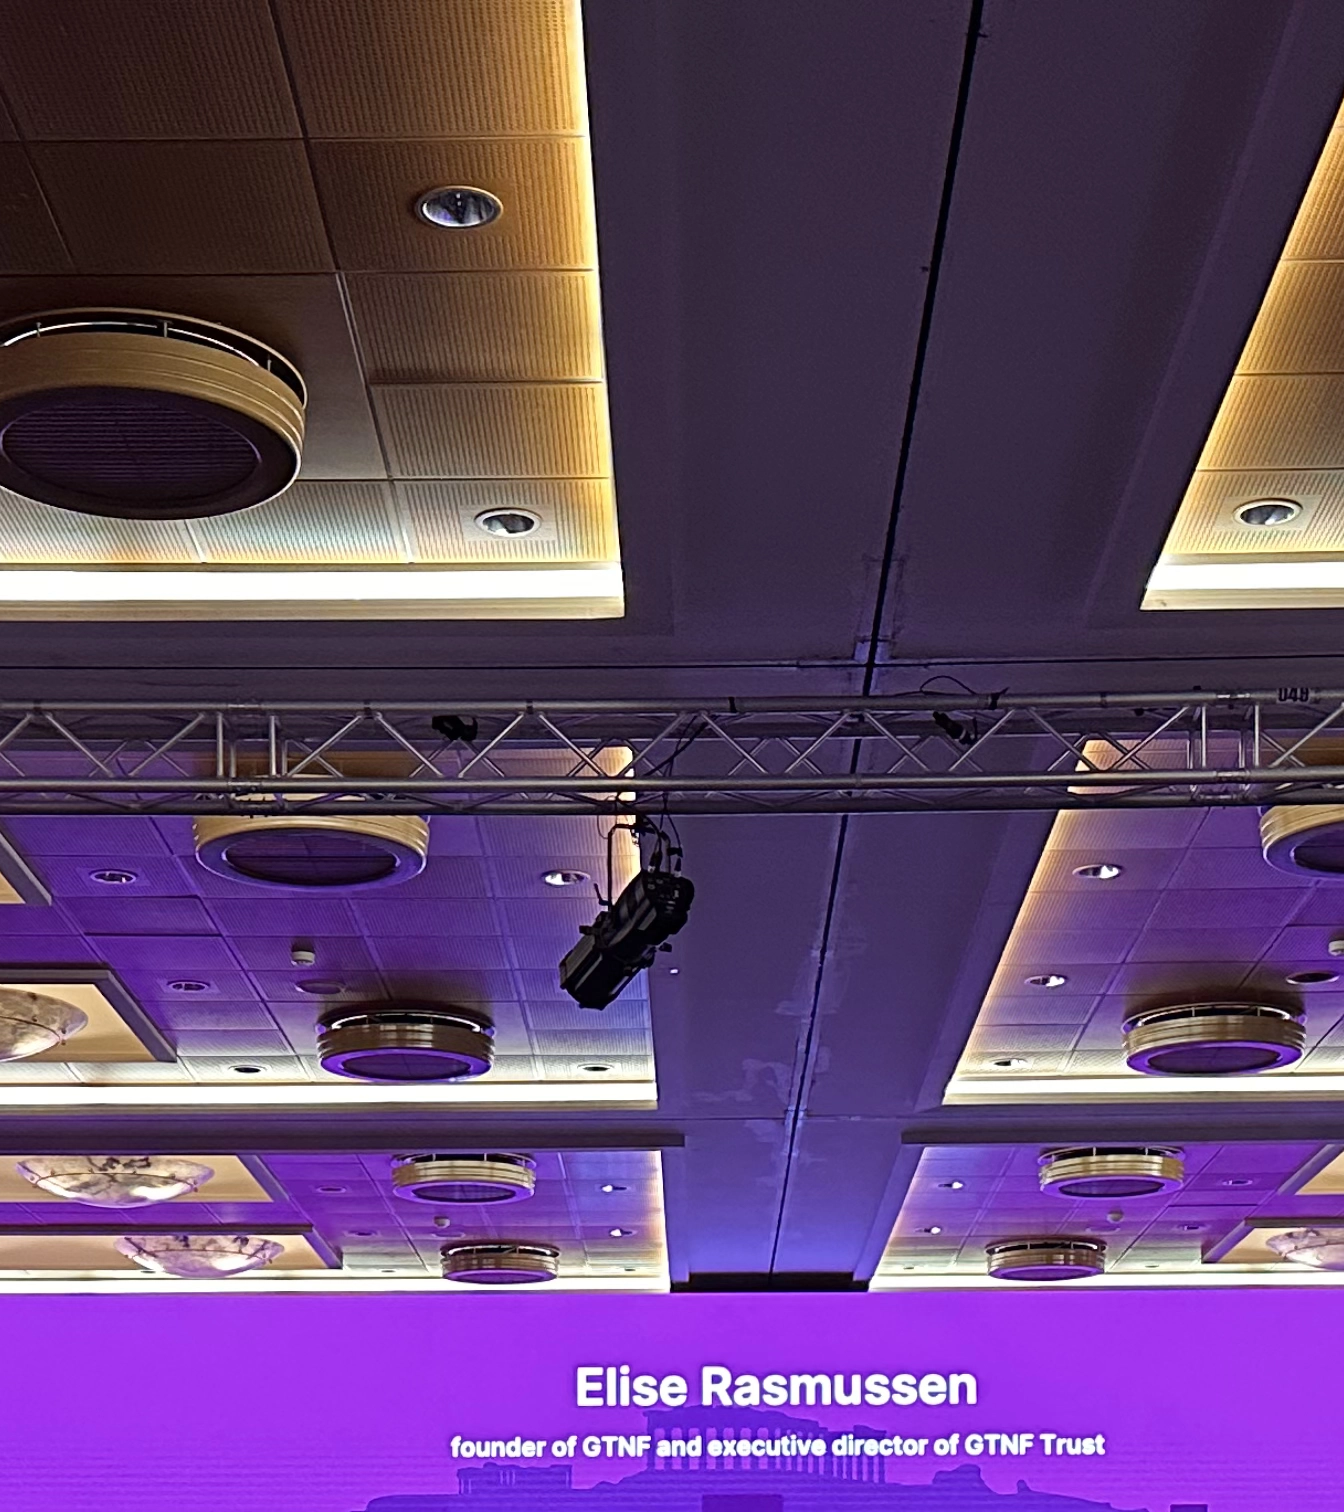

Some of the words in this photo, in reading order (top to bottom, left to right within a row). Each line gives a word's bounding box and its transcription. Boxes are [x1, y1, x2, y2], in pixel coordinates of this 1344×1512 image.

[576, 1364, 688, 1407] Elise
[701, 1366, 977, 1407] Rasmussen
[450, 1435, 547, 1458] founder
[551, 1435, 578, 1458] of
[582, 1435, 652, 1458] GTNF
[655, 1435, 702, 1458] and
[706, 1434, 827, 1457] executive
[831, 1433, 929, 1457] director
[933, 1433, 960, 1456] of
[964, 1433, 1035, 1456] GTNF
[1039, 1433, 1106, 1456] Trust
